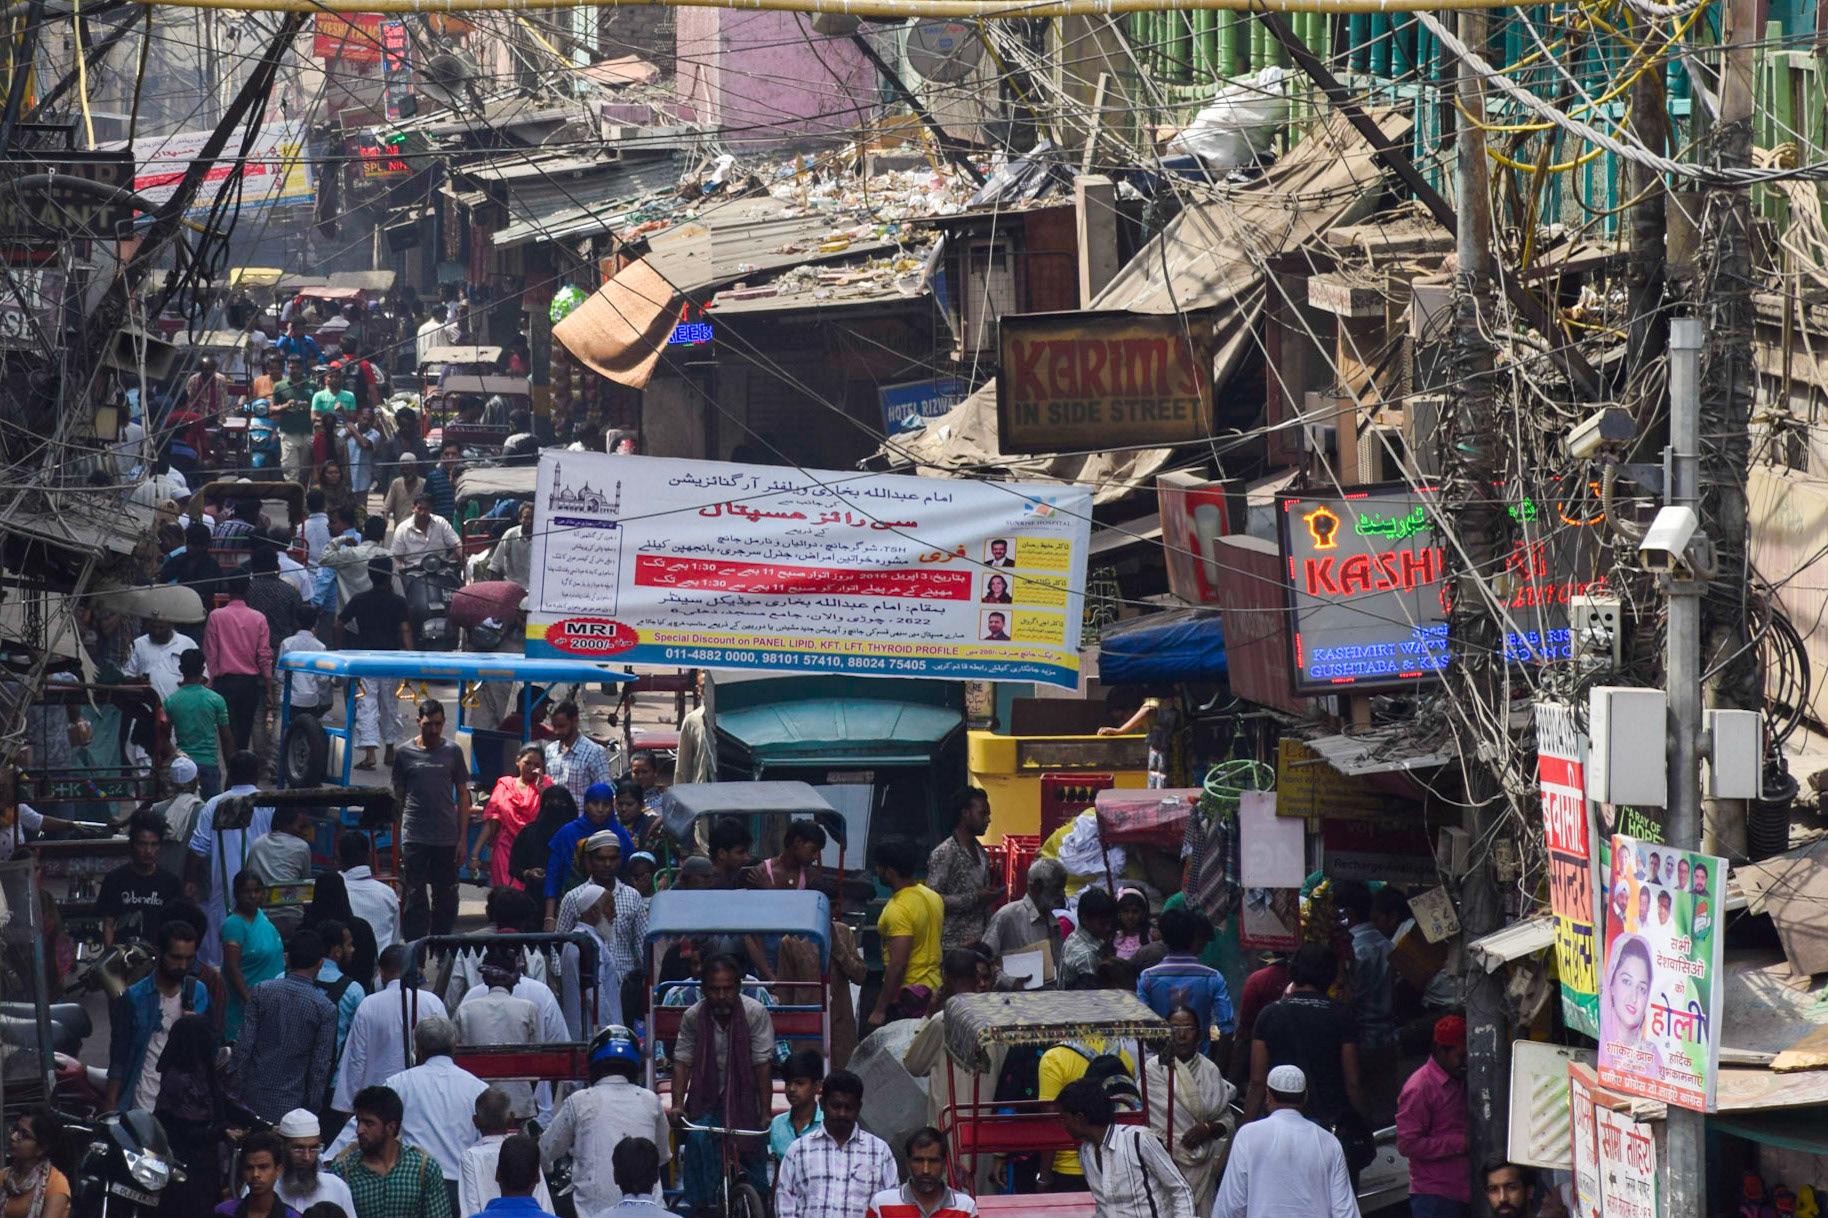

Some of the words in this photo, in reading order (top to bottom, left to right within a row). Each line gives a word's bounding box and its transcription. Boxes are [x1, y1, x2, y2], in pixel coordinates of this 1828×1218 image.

[1014, 402, 1040, 426] IN
[1048, 400, 1102, 425] SIDE
[1109, 397, 1202, 422] STREET
[692, 563, 716, 571] 1:30
[702, 579, 727, 587] 1:30
[566, 622, 616, 637] MRI
[654, 632, 689, 644] Special
[692, 634, 735, 645] Discount
[738, 638, 750, 646] on
[753, 637, 786, 648] PANEL
[789, 639, 817, 650] LIPID,
[820, 641, 842, 651] KFT,
[844, 642, 865, 652] LFT,
[867, 643, 913, 654] THYROID
[915, 646, 959, 656] PROFILE
[1312, 643, 1396, 662] KASHMIRI
[665, 647, 722, 661] 011-4882
[725, 651, 759, 665] 0000,
[762, 653, 799, 665] 98101
[803, 654, 845, 668] 57410,
[847, 657, 886, 669] 88024
[889, 659, 927, 670] 75405
[1310, 660, 1400, 679] GUSHTABA
[1402, 659, 1415, 670] &
[1670, 936, 1691, 953] सभी
[1674, 981, 1685, 994] को
[1650, 992, 1707, 1045] होली
[1636, 1050, 1655, 1063] खान
[1669, 1050, 1692, 1067] हार्दिक
